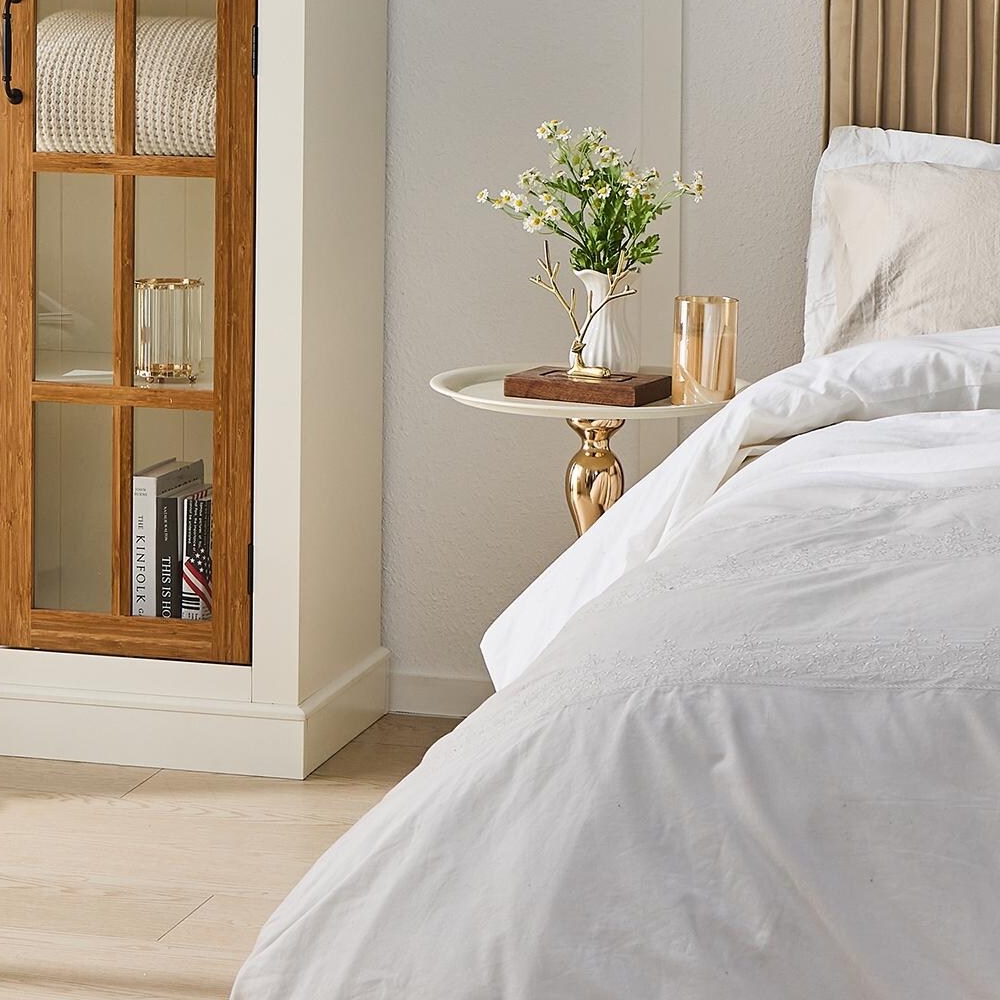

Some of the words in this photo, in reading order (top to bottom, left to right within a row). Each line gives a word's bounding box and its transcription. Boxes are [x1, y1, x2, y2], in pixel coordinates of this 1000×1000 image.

[135, 535, 146, 604] KINFOLK
[161, 556, 172, 584] THIS
[161, 587, 172, 598] IS
